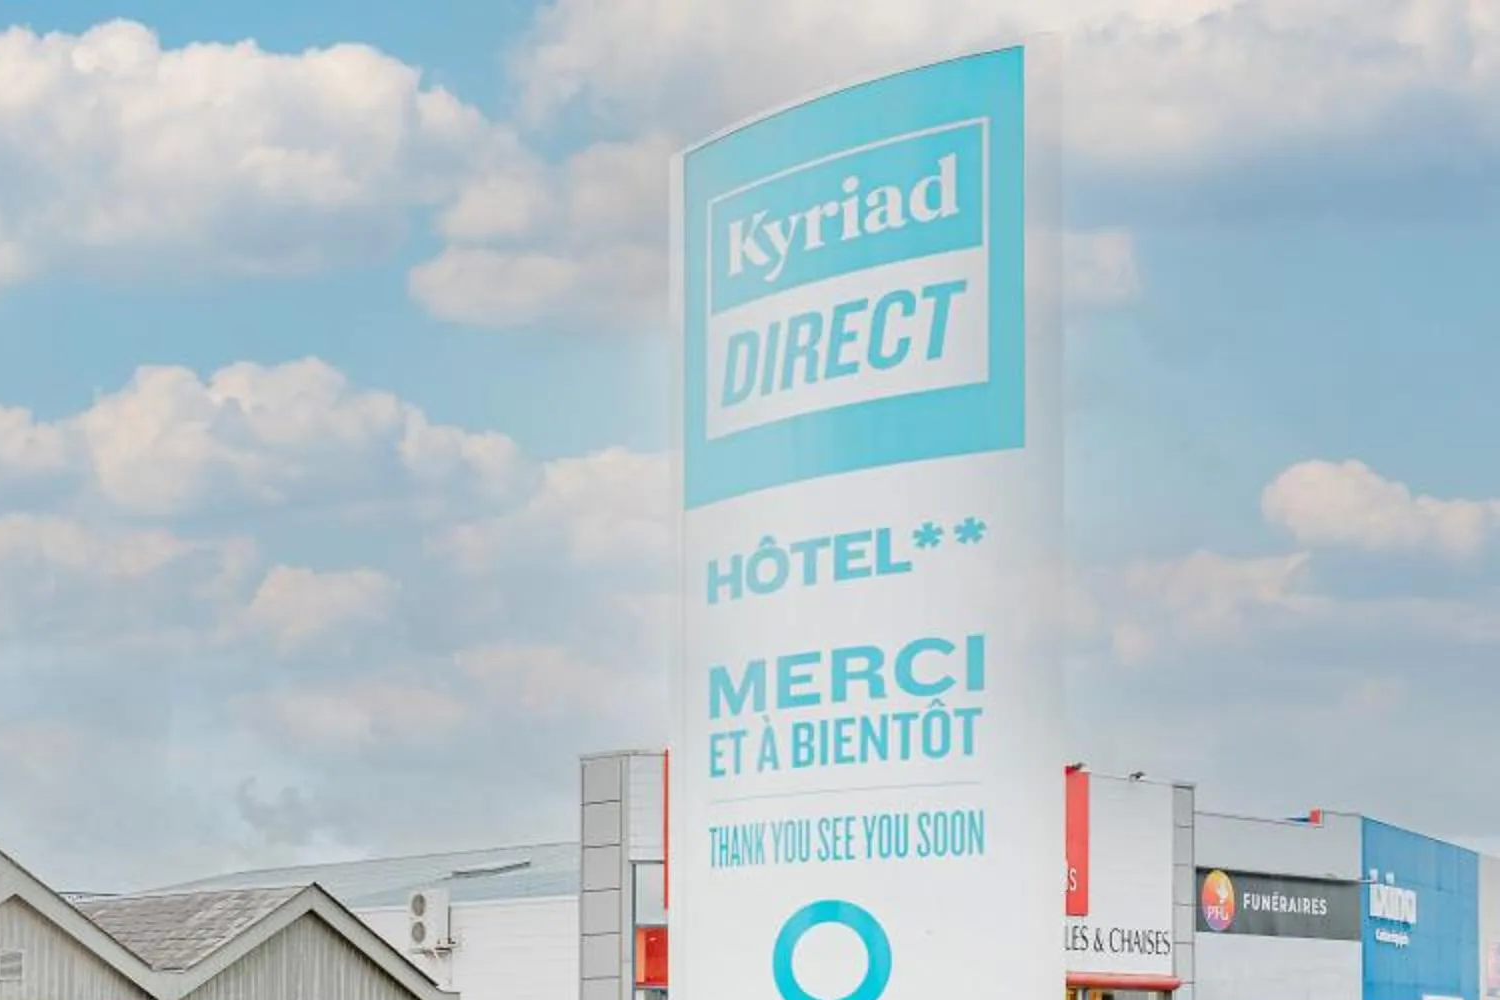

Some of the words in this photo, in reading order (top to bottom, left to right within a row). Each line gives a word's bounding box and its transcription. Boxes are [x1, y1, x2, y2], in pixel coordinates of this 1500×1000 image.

[728, 153, 960, 282] Kyriad
[721, 279, 968, 408] DIRECT
[709, 633, 985, 720] MERCI
[709, 730, 748, 779] ET
[757, 714, 780, 772] À
[791, 698, 983, 769] BIENTÔT
[709, 823, 766, 868] THANK
[770, 818, 811, 863] YOU
[817, 816, 856, 862] SEE
[862, 814, 909, 858] YOU
[917, 809, 985, 857] SOON
[1094, 928, 1104, 953] &
[1109, 927, 1171, 955] CHAISES
[1243, 891, 1328, 915] FUNÉRAIRES
